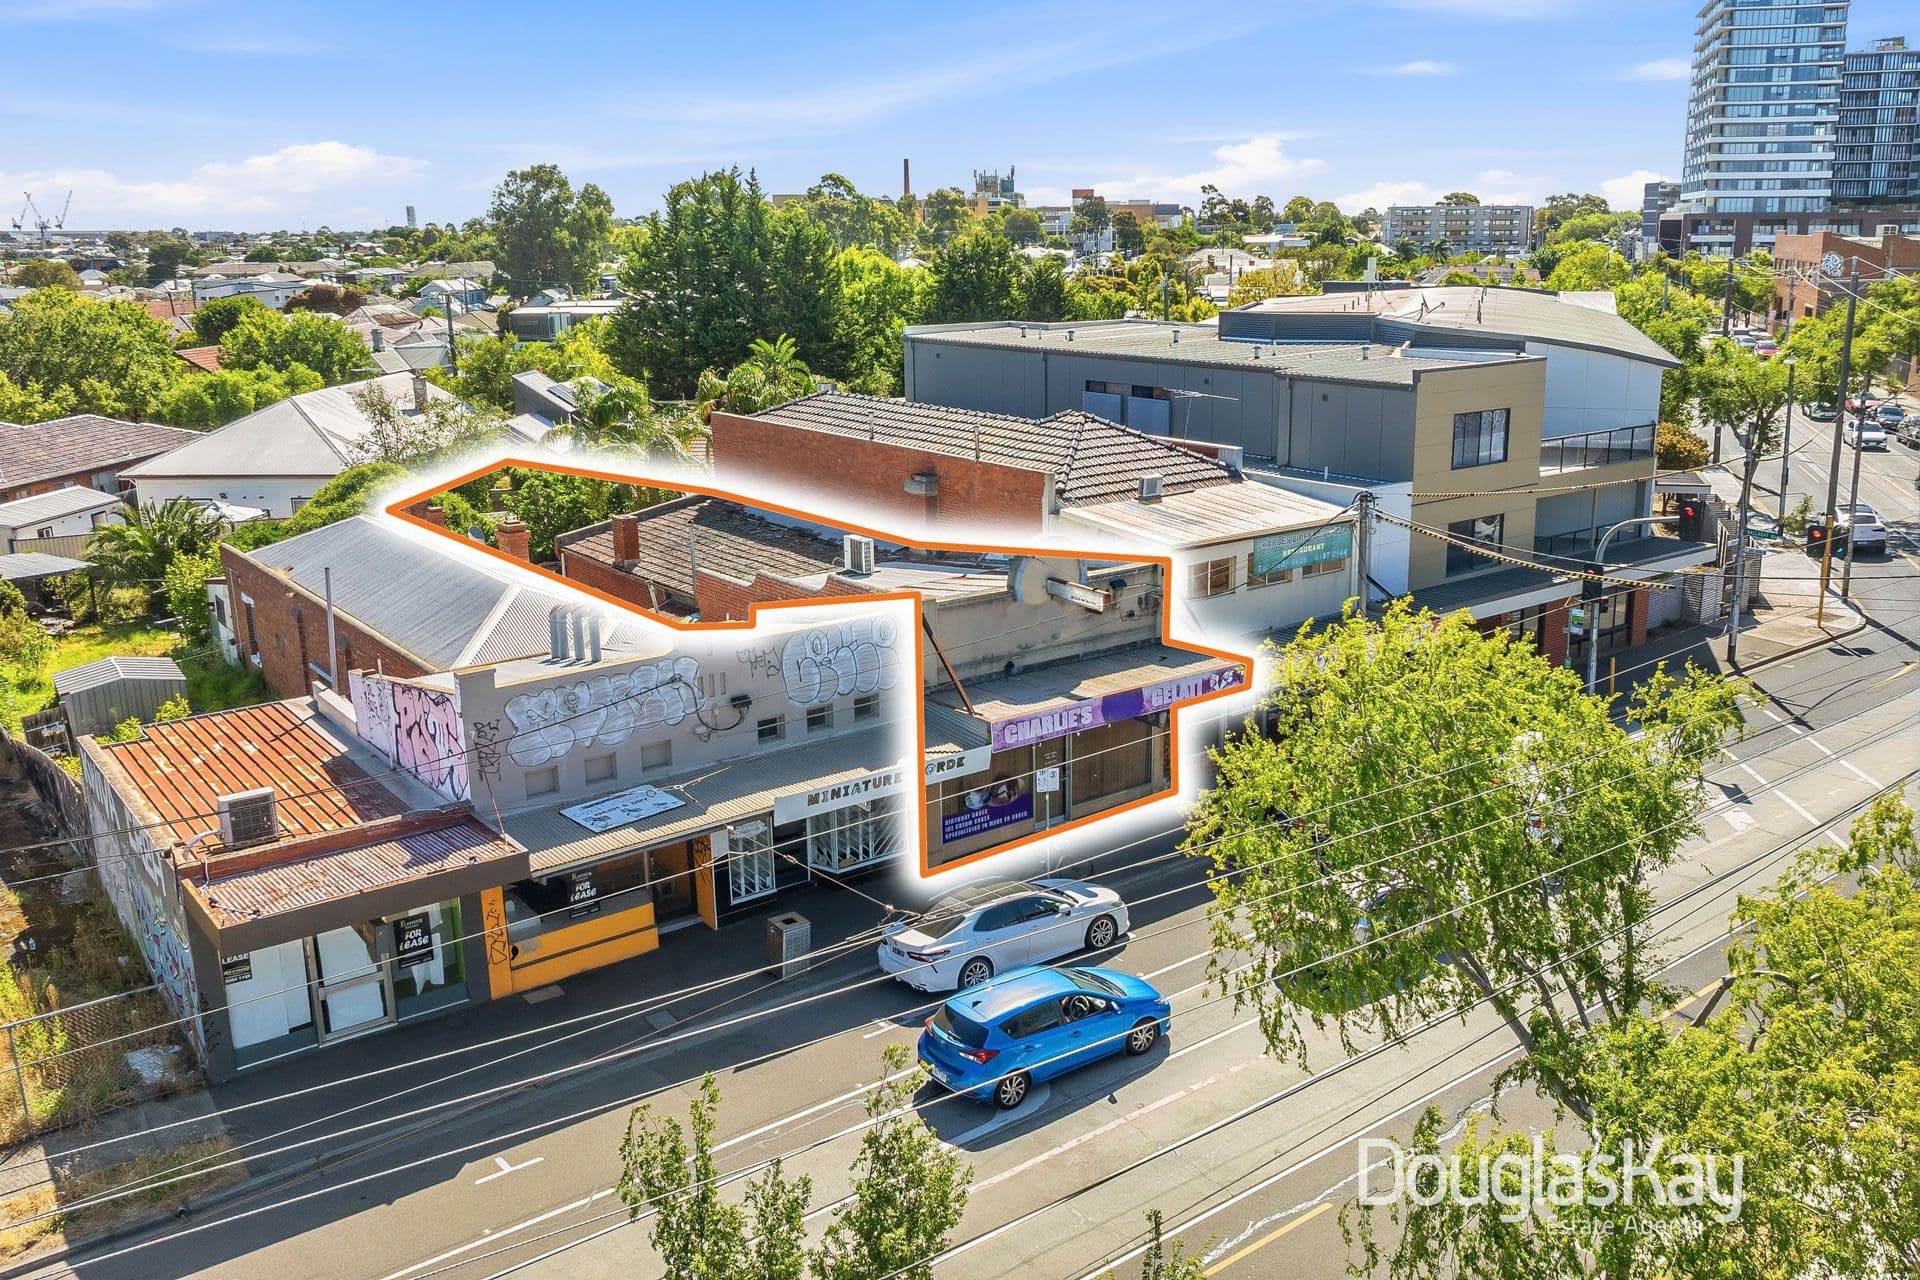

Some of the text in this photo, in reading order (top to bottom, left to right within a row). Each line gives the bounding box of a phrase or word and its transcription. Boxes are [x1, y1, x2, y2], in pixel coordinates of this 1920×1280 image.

[1004, 704, 1093, 744] CHARLIE'S
[807, 756, 966, 807] MINIATURE ORDE
[576, 881, 591, 892] FOR
[570, 888, 597, 902] LEASE
[404, 928, 422, 941] FOR
[399, 935, 430, 951] LEASE
[221, 952, 250, 965] LEASE
